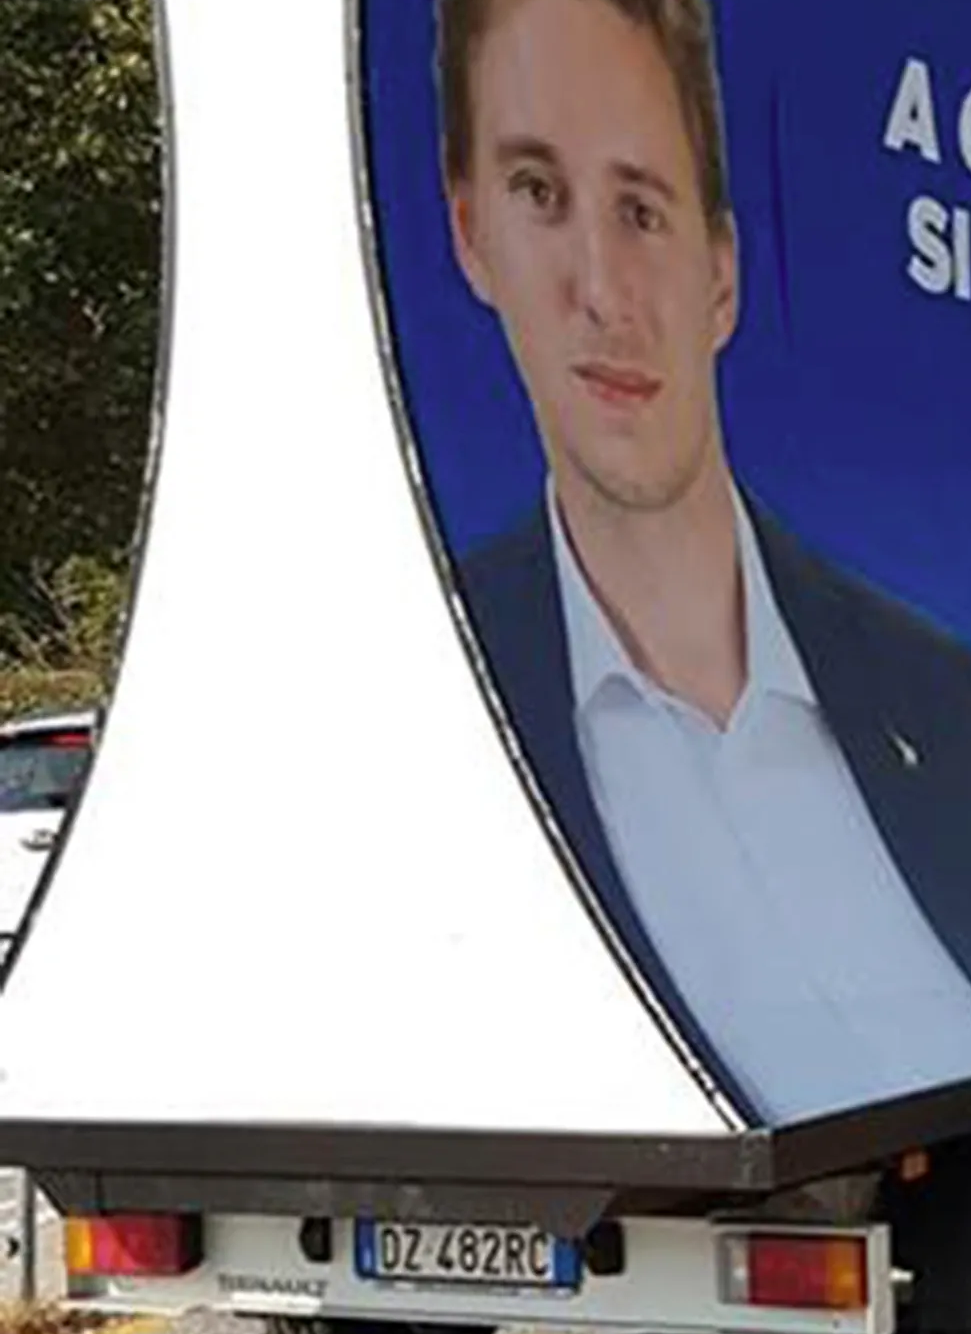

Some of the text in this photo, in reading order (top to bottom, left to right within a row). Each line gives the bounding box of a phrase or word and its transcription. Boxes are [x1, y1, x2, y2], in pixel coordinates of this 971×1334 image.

[883, 57, 941, 162] A
[381, 1227, 424, 1269] DZ
[436, 1229, 551, 1277] 482RC
